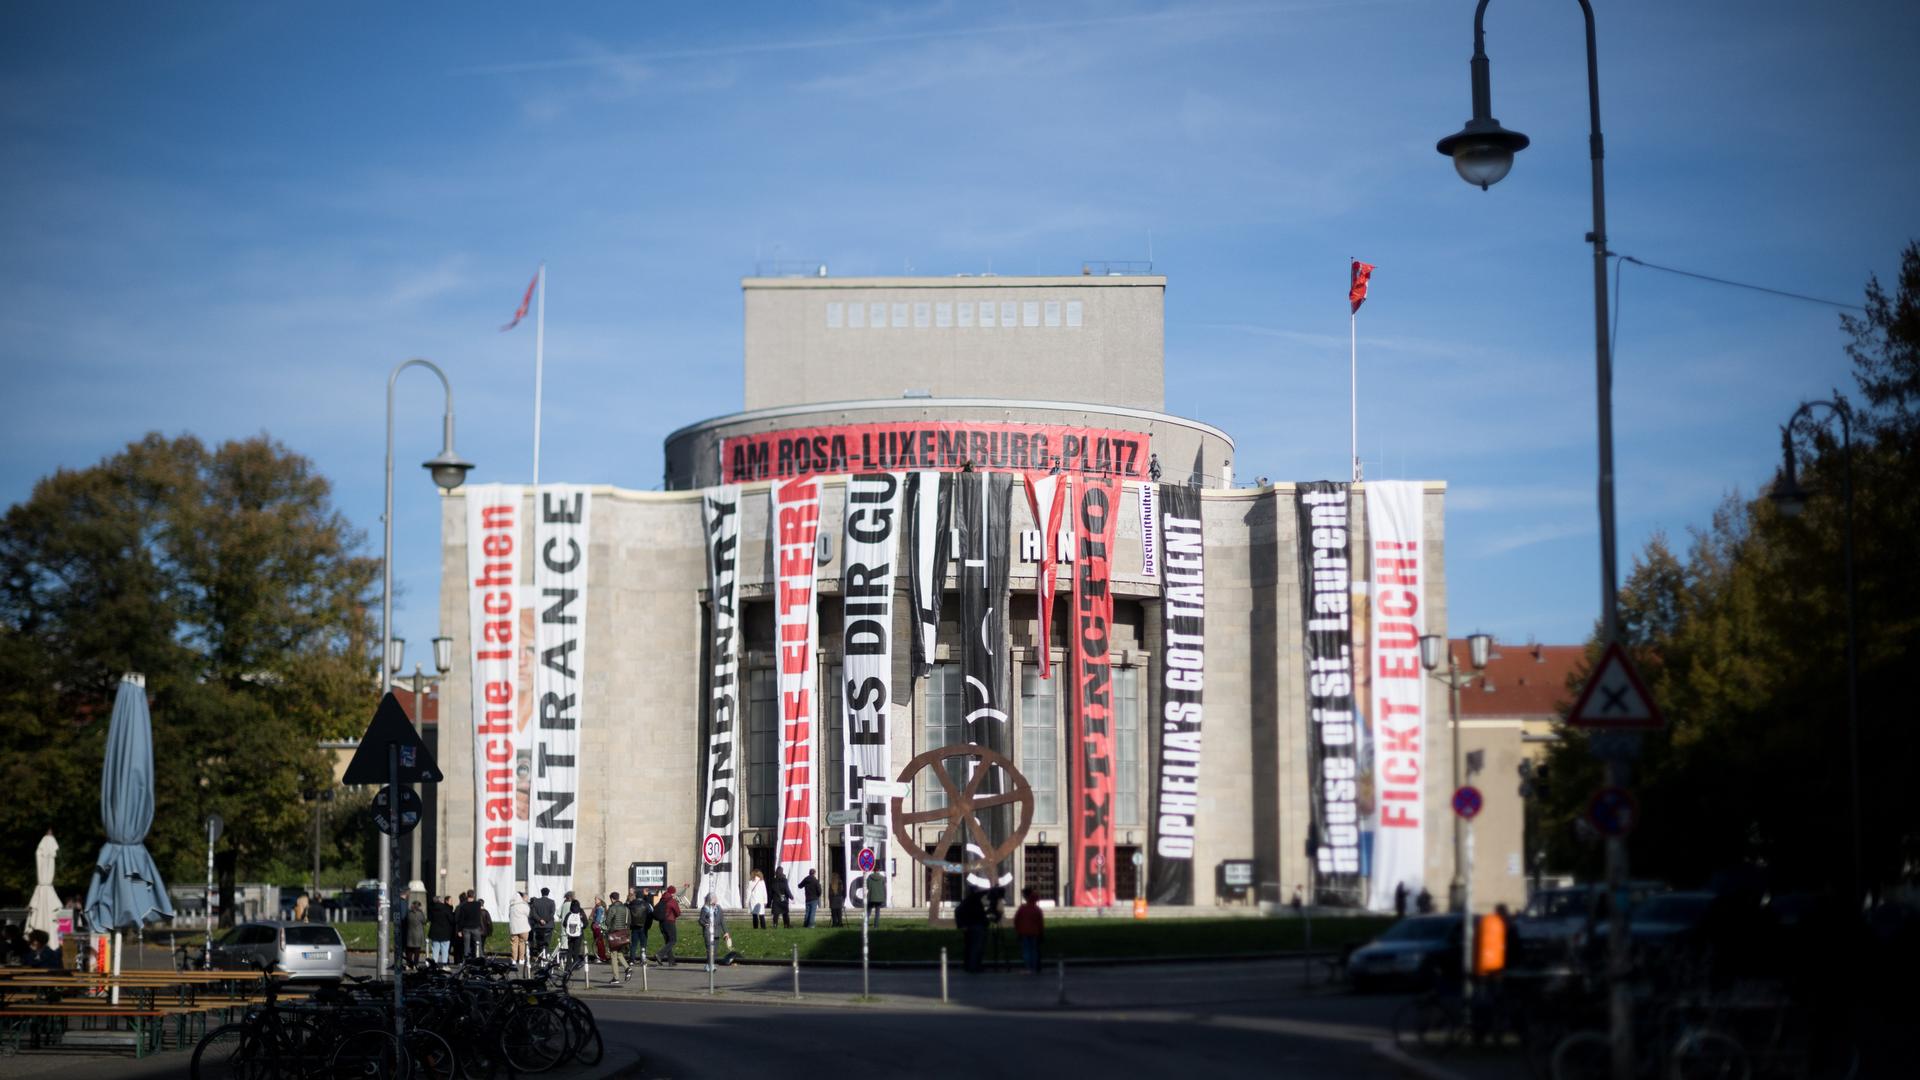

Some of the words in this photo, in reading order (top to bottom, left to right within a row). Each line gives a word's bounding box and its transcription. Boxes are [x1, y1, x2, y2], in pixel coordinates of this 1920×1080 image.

[733, 441, 769, 481] AM
[475, 505, 515, 660] lachen
[845, 562, 888, 655] DIR
[1164, 513, 1204, 620] TALENT
[1303, 490, 1348, 632] Laurent
[1375, 540, 1419, 680] EUCH!
[533, 492, 584, 876] ENTRANCE
[848, 675, 887, 746] ES
[1166, 630, 1204, 691] GOT
[1311, 644, 1351, 697] St.
[477, 679, 515, 866] manche
[1158, 700, 1202, 859] OPHELIA'S
[1313, 708, 1352, 746] of
[1379, 697, 1420, 828] FICKT
[707, 842, 720, 856] 30
[1317, 757, 1359, 873] House
